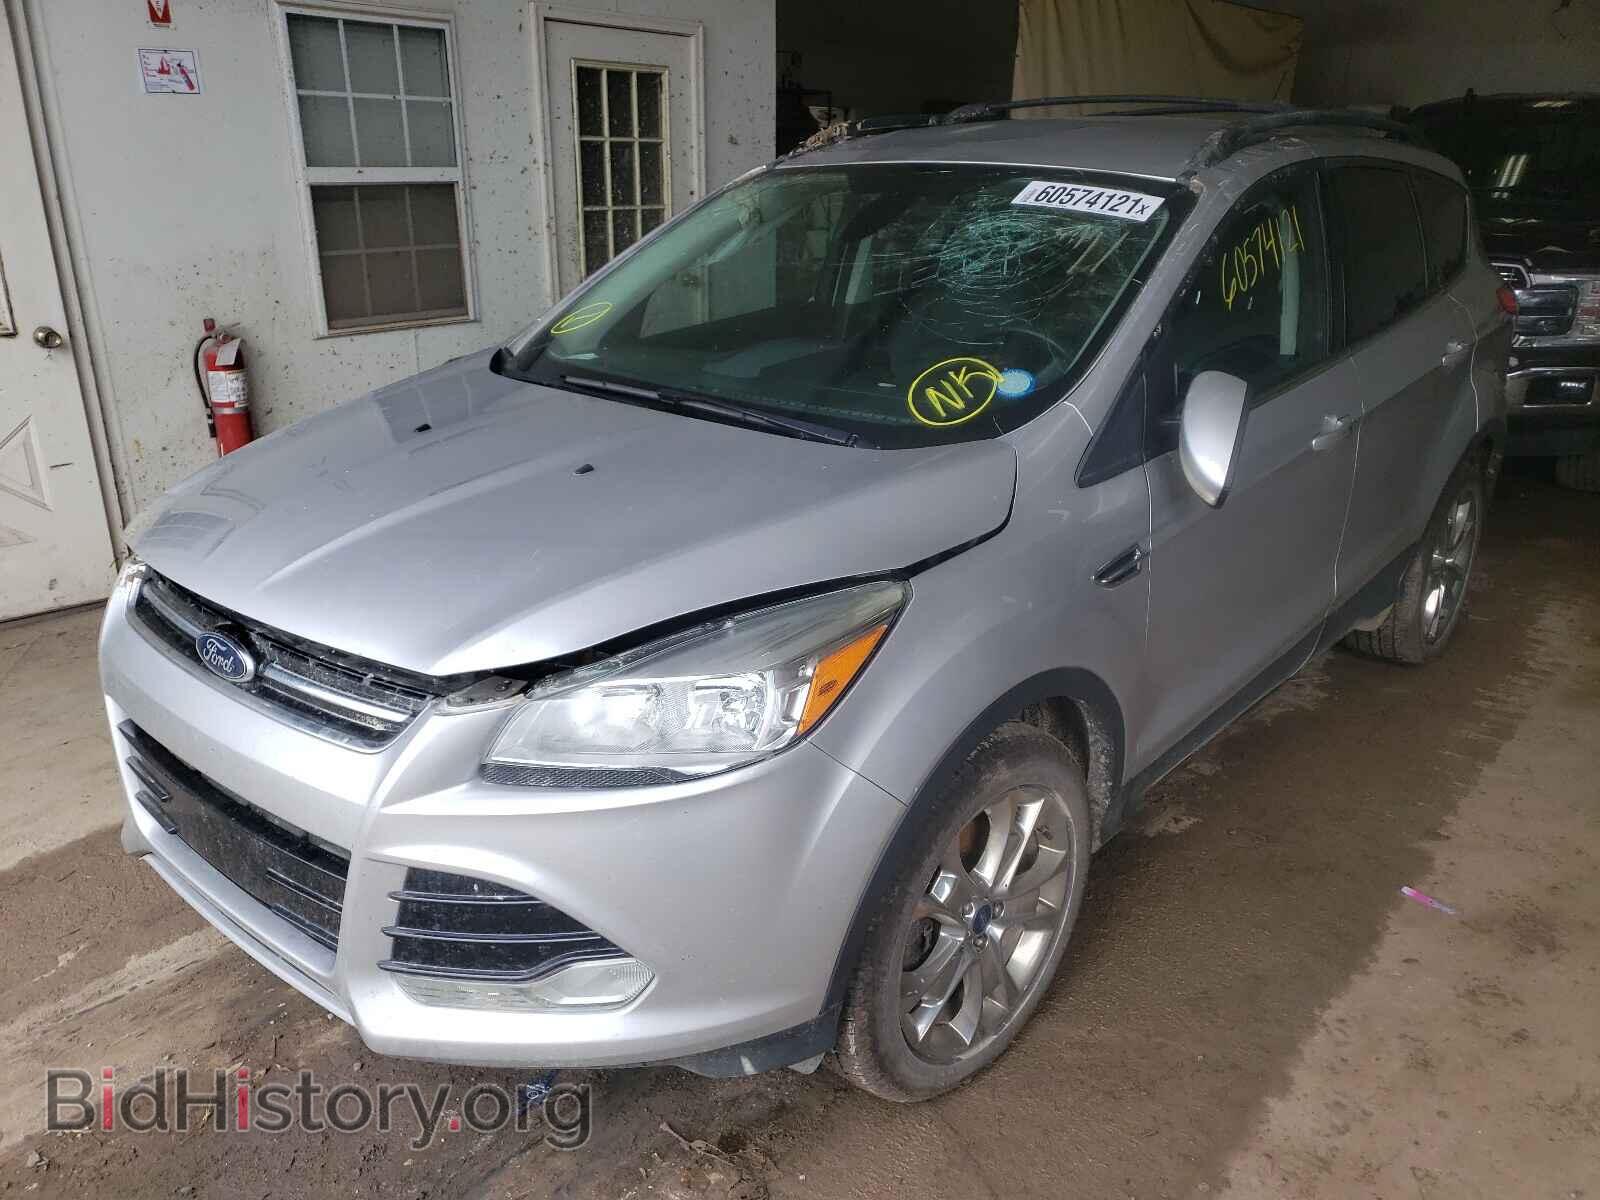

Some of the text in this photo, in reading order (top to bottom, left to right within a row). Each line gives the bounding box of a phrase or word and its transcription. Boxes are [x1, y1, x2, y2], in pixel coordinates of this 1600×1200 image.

[1222, 205, 1305, 313] 60574121
[925, 366, 998, 417] NK
[203, 638, 235, 673] Ford
